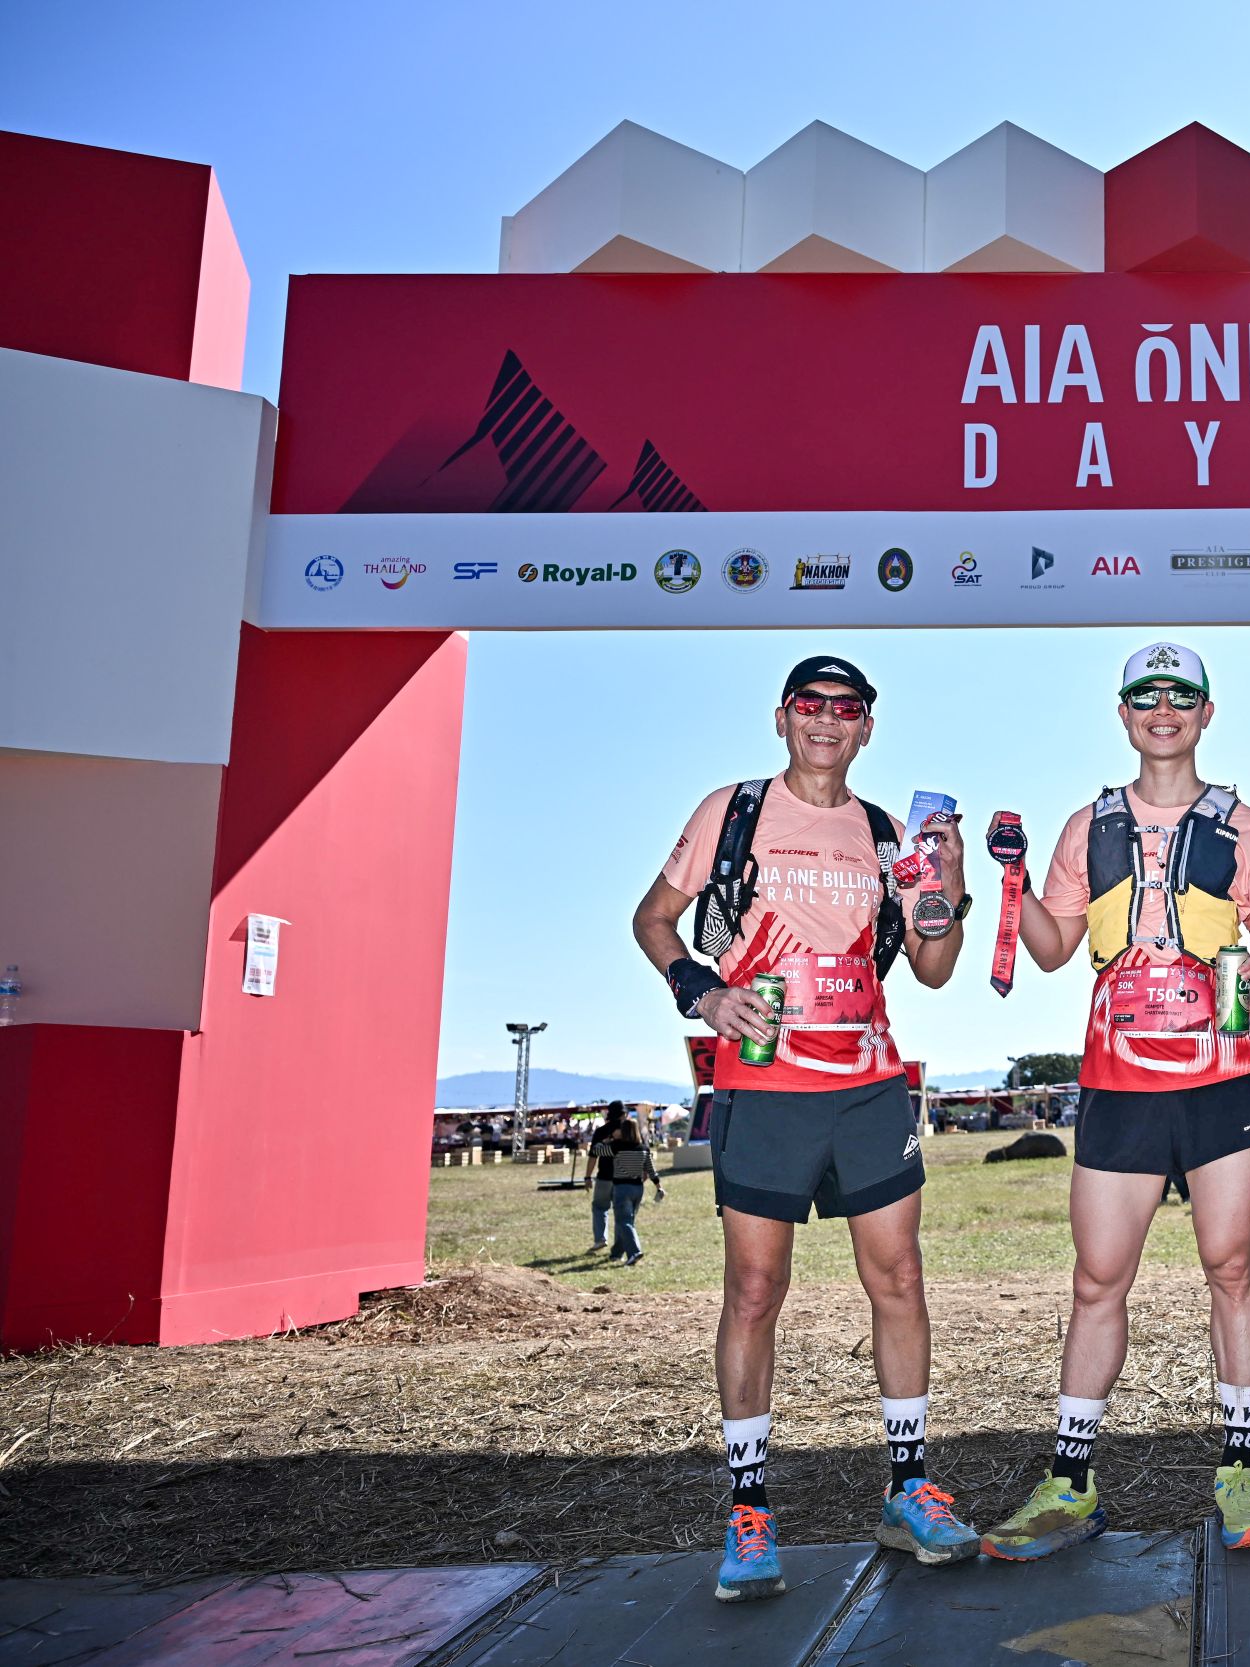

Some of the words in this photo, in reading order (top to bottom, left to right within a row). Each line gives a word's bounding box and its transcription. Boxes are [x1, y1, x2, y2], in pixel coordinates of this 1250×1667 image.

[960, 324, 1105, 404] AIA
[363, 563, 427, 575] THAILAND
[453, 562, 498, 580] SF
[542, 562, 638, 586] Royal-D
[804, 563, 851, 579] NAKHON
[1091, 556, 1141, 576] AIA
[954, 573, 983, 585] SAT
[1215, 827, 1239, 842] KIPRUN
[768, 848, 820, 857] SKECHERS
[780, 969, 800, 979] 50K
[815, 977, 864, 993] T504A
[1118, 981, 1134, 990] 50K
[1147, 987, 1199, 1004] T504D
